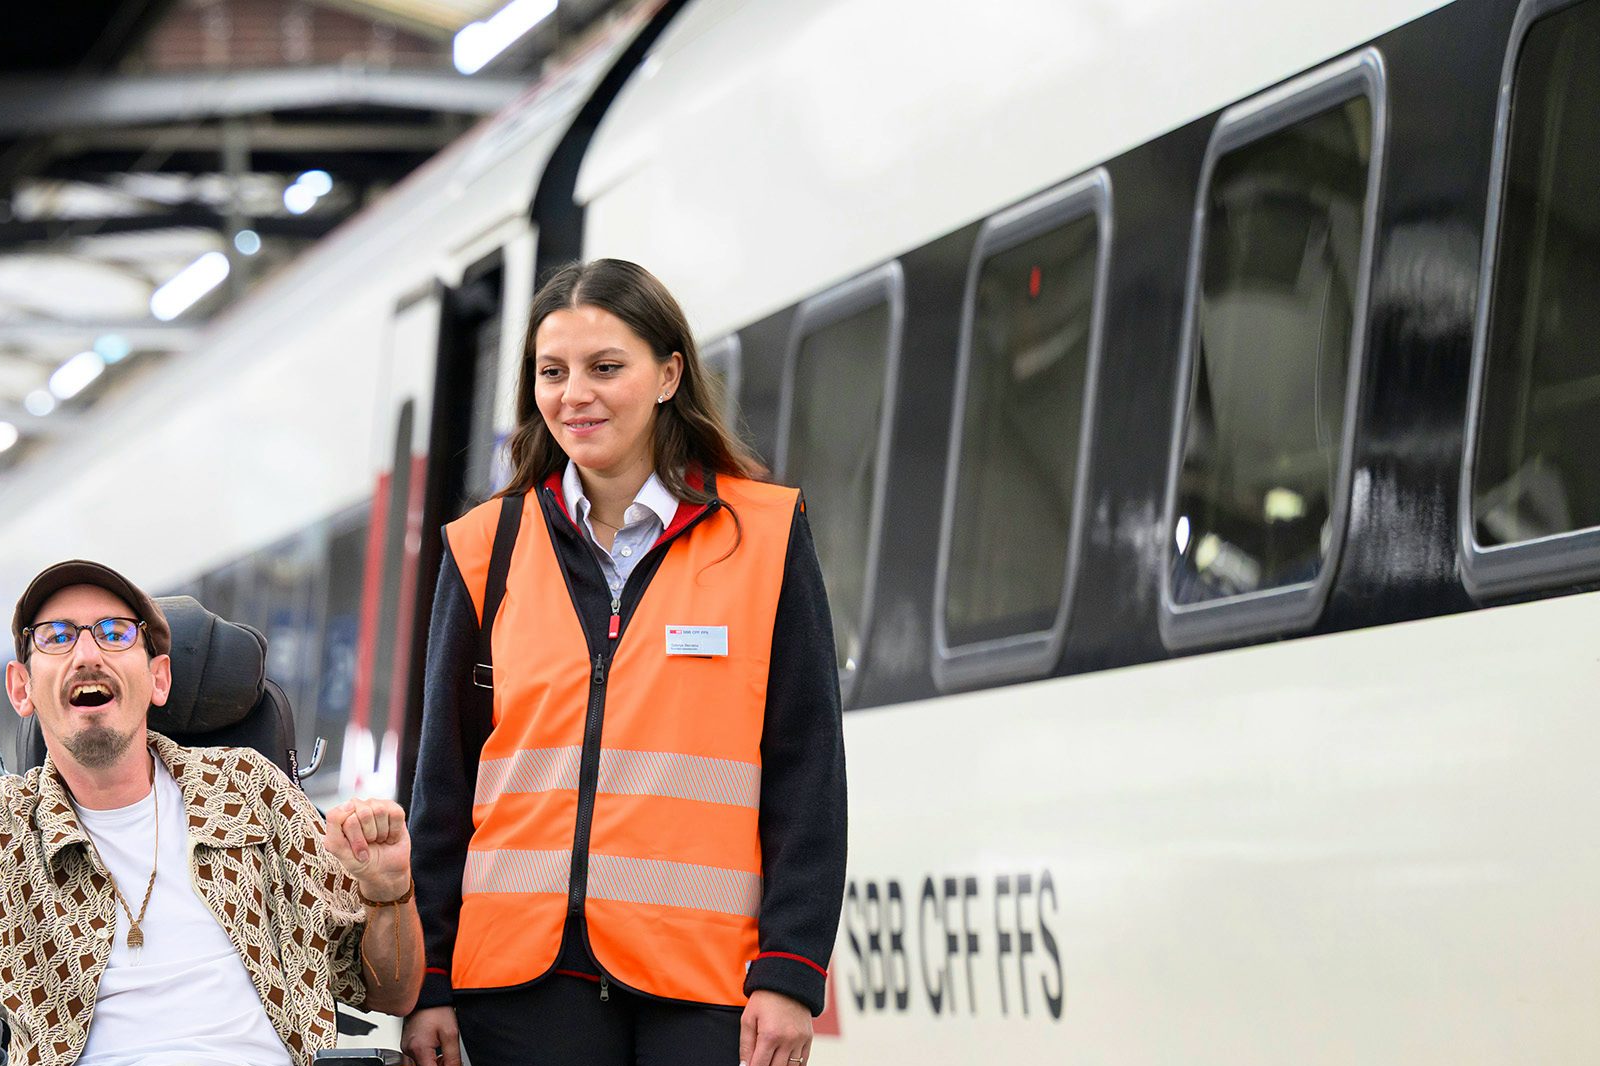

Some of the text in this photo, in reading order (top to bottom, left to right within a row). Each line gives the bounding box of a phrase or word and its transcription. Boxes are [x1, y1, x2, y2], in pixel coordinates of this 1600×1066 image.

[845, 868, 1064, 1020] SBB CFF FFS
